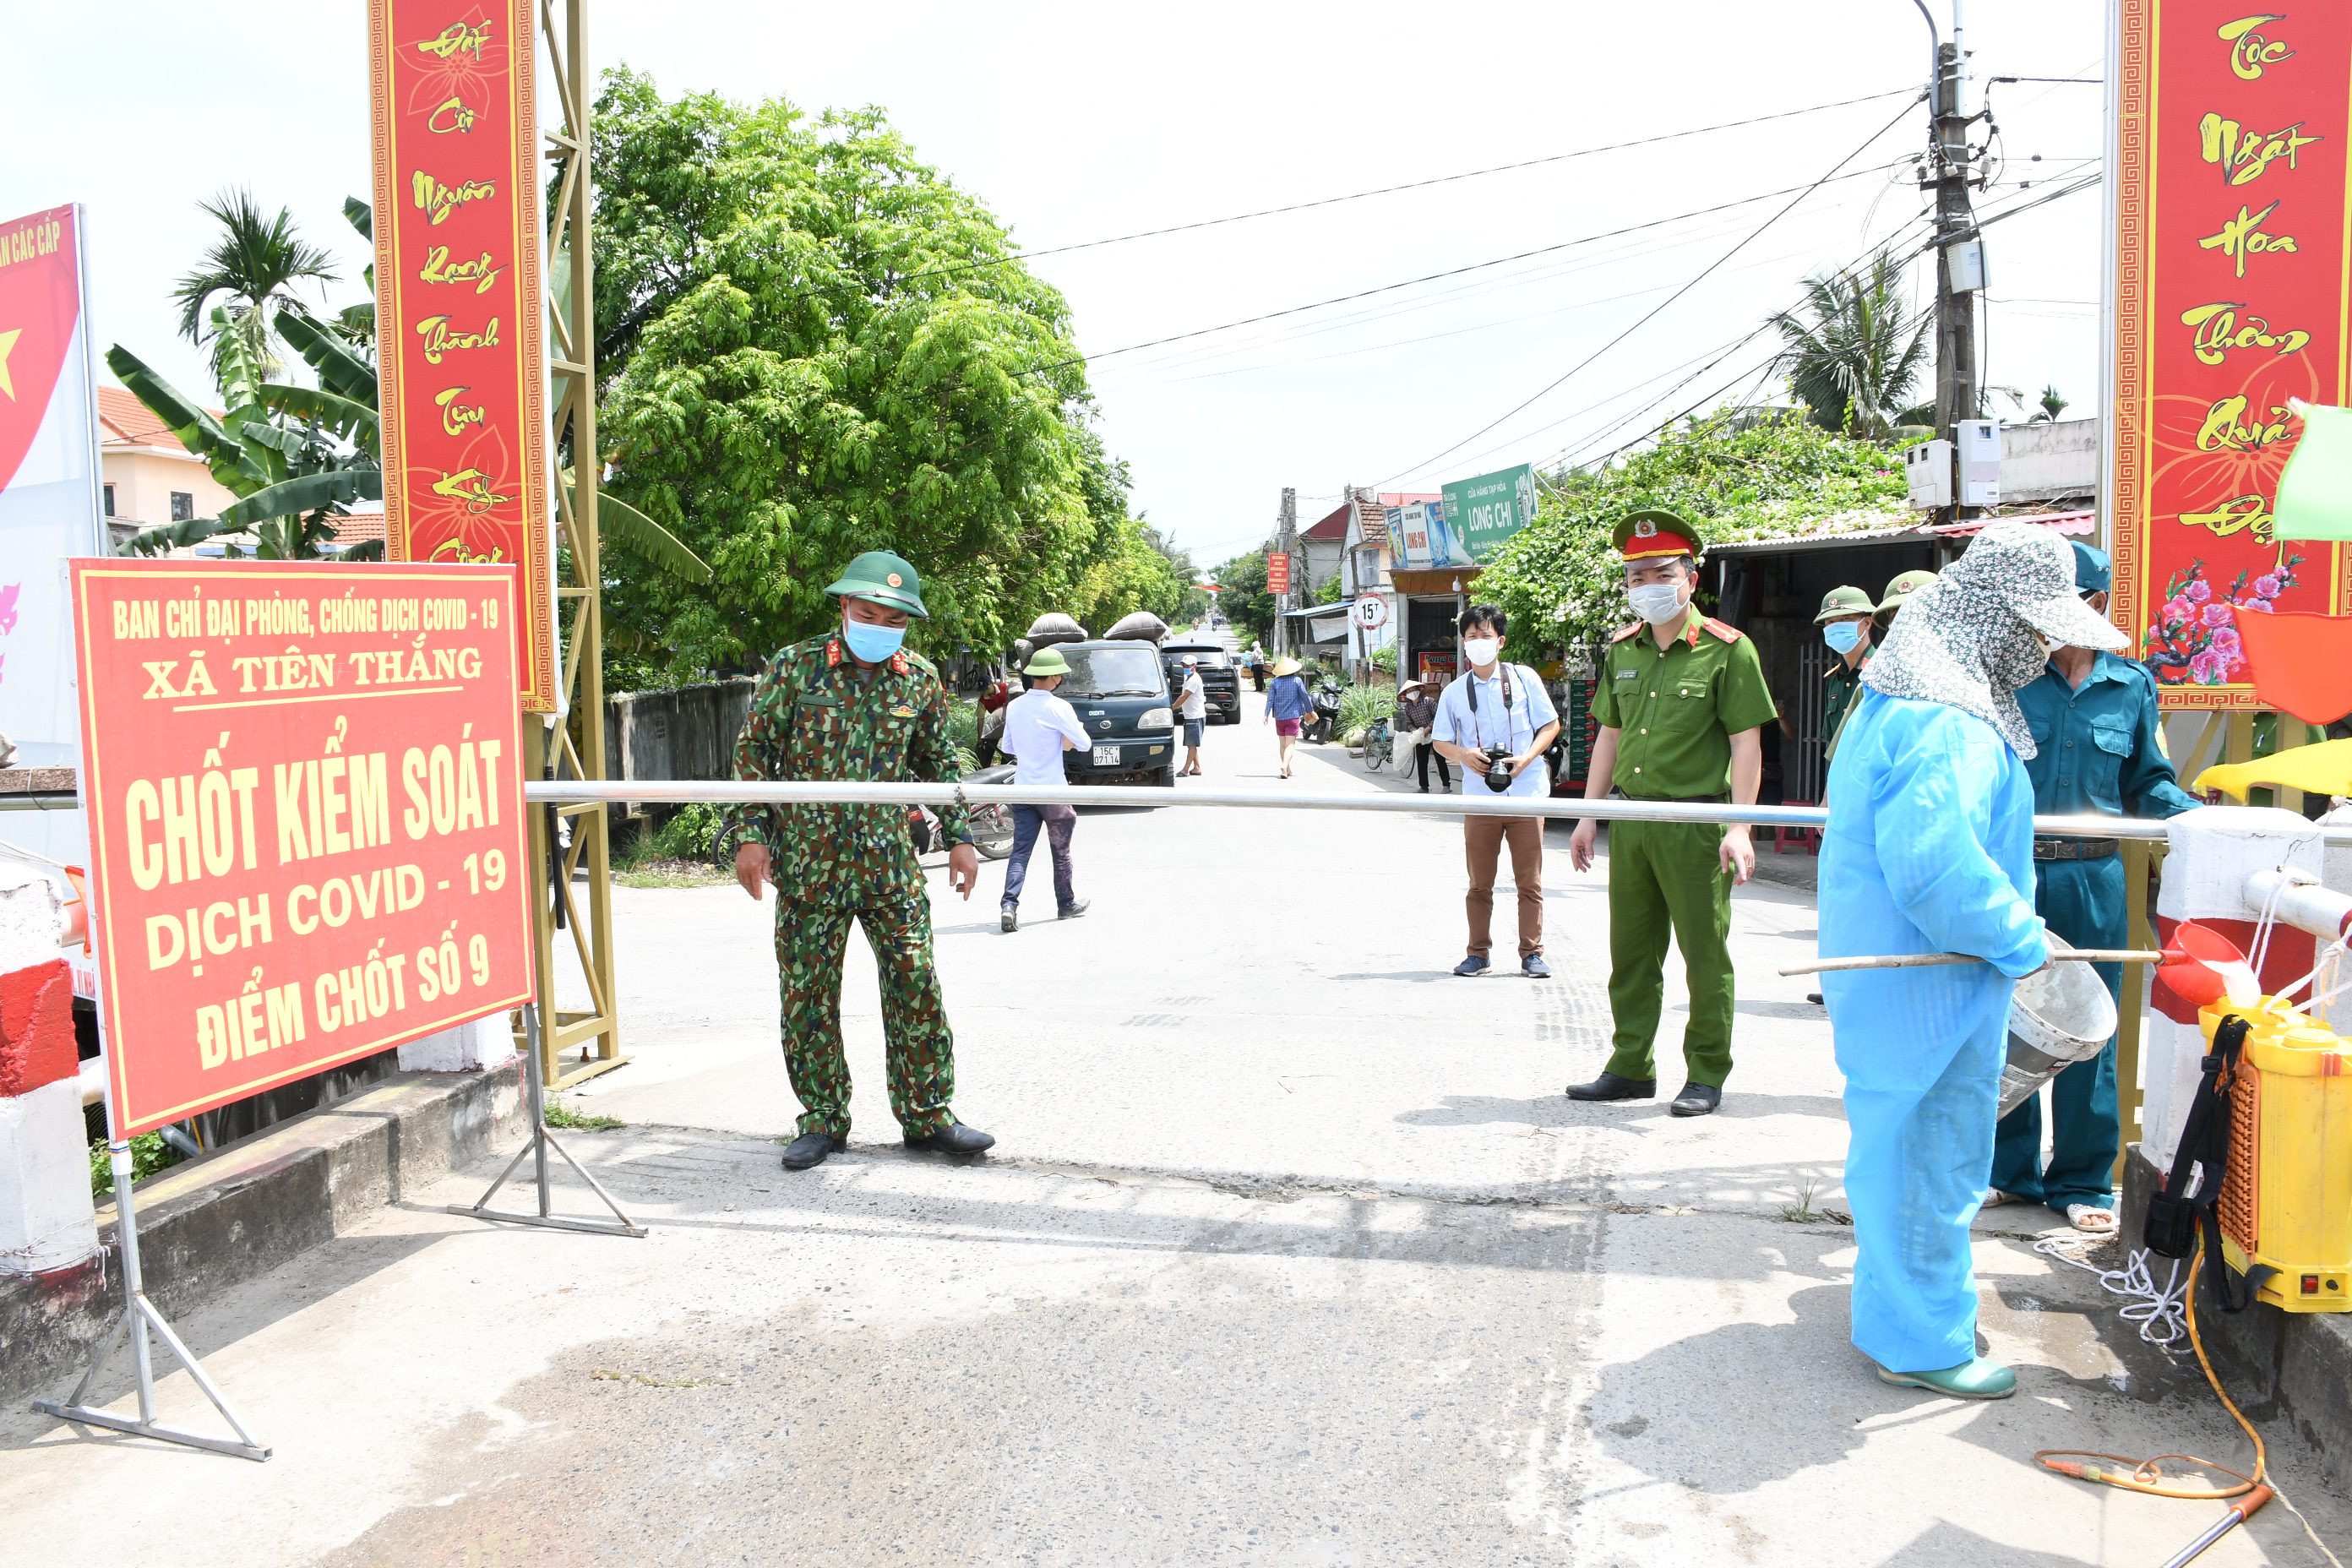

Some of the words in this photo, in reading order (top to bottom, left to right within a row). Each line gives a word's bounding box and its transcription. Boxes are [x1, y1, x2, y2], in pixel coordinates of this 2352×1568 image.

[2217, 14, 2296, 80] Tộc
[427, 95, 476, 133] Cội
[12, 224, 35, 264] CÁC
[36, 210, 61, 256] CẤP
[2197, 199, 2299, 279] Hoa
[419, 245, 509, 294] Rạng
[2197, 394, 2294, 452] Quả
[1467, 504, 1493, 531] LONG
[1494, 501, 1513, 528] CHI
[2178, 494, 2285, 567] Đẹ
[112, 600, 160, 640] BAN
[166, 585, 201, 639] CHỈ
[205, 599, 241, 645] ĐẠI
[245, 590, 315, 639] PHÒNG,
[319, 586, 378, 634] CHỐNG
[381, 597, 419, 640] DỊCH
[422, 597, 467, 631] COVID
[481, 598, 498, 629] 19
[142, 650, 218, 700] XÃ
[231, 645, 336, 693] TIÊN
[348, 632, 483, 685] THẮNG
[1100, 747, 1113, 756] 15C
[125, 731, 259, 891] CHỐT
[273, 715, 391, 866] KIỂM
[401, 722, 501, 841] SOÁT
[145, 892, 273, 978] DỊCH
[286, 863, 425, 935] COVID
[463, 848, 506, 896] 19
[195, 965, 306, 1070] ĐIỂM
[314, 938, 406, 1033] CHỐT
[416, 919, 461, 1002] SỐ
[468, 934, 490, 987] 9
